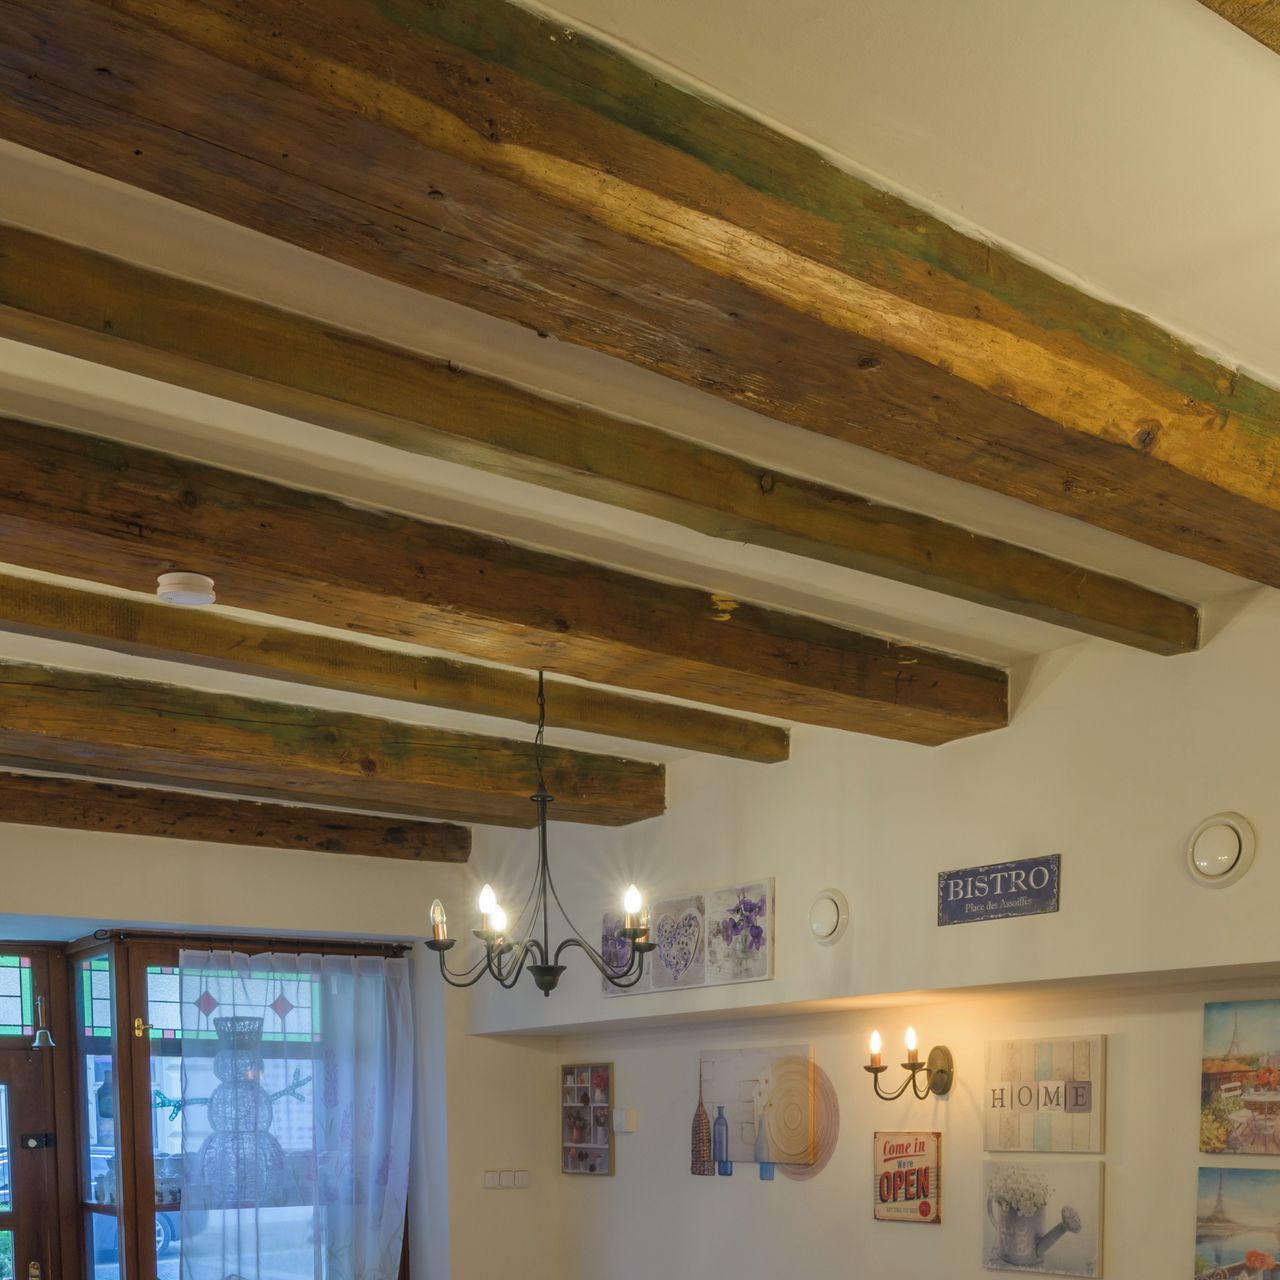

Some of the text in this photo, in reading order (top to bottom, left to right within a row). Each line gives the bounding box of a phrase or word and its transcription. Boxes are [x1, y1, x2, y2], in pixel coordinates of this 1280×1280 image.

[947, 866, 1049, 901] BISTRO
[965, 902, 985, 913] Place
[991, 1085, 1088, 1108] HOME
[883, 1137, 925, 1156] Come in
[880, 1166, 929, 1203] OPEN
